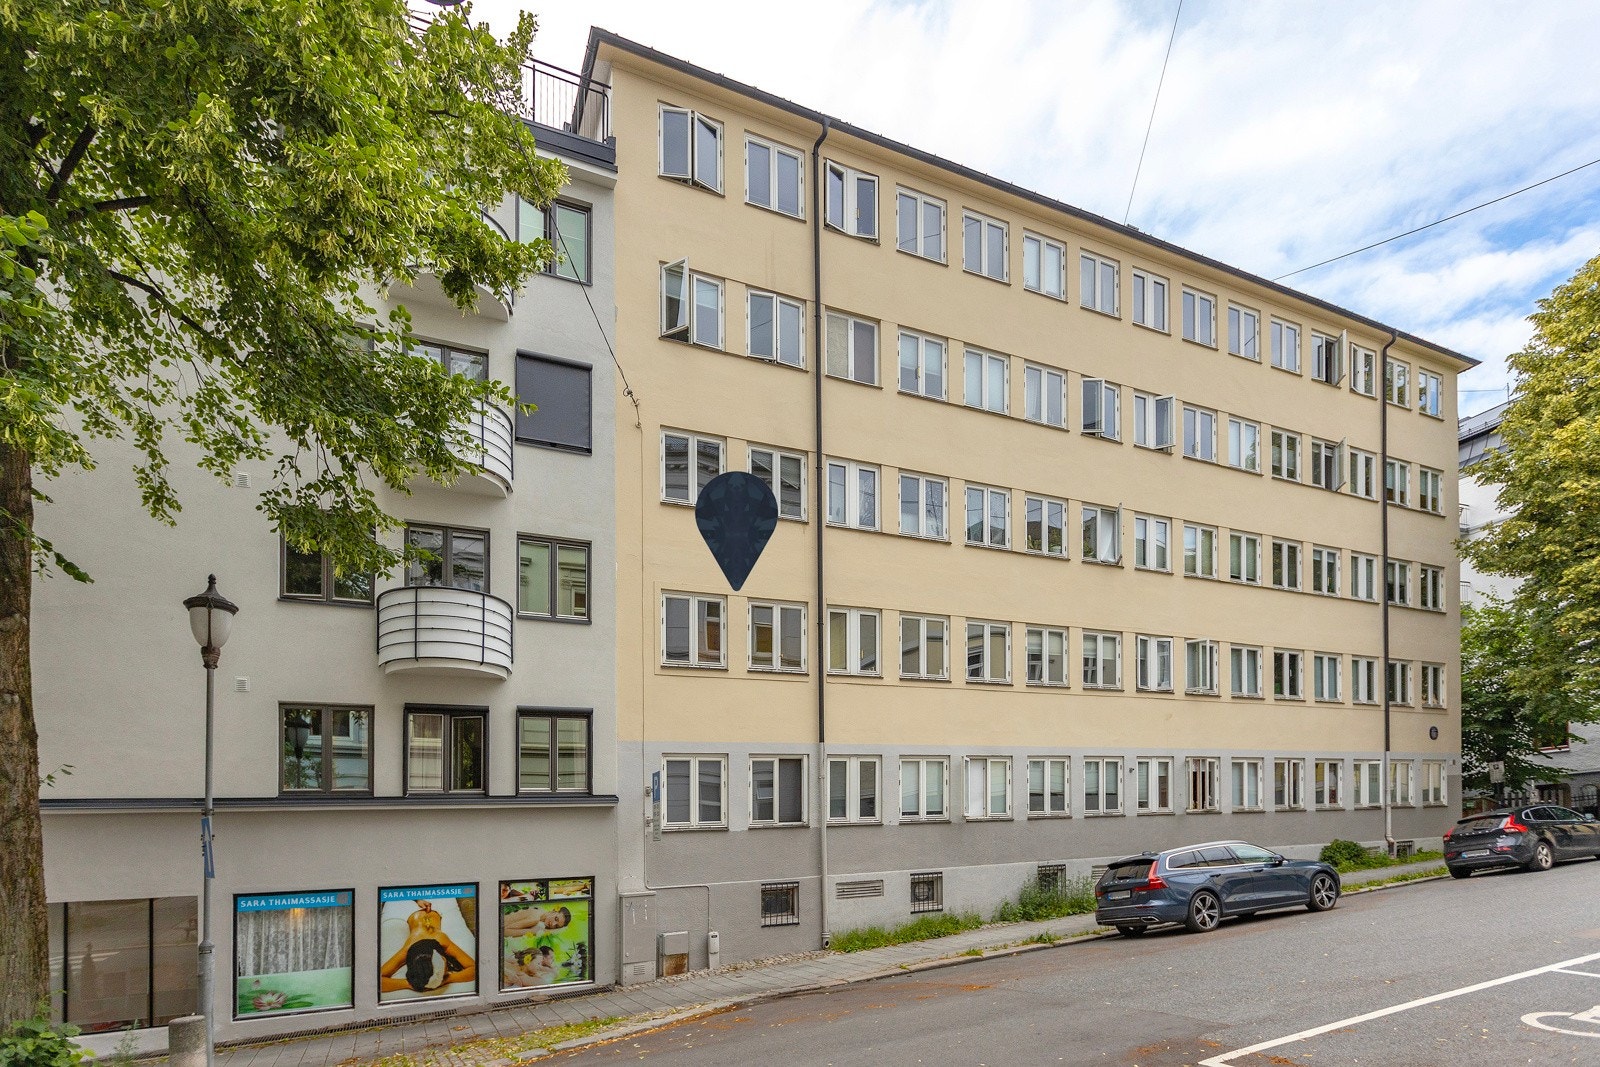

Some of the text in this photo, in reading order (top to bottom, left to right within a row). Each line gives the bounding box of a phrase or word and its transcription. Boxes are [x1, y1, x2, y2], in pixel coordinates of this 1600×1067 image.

[383, 888, 462, 899] SARA THAIMASSASJE
[240, 895, 336, 908] SARA THAIMASSASJE
